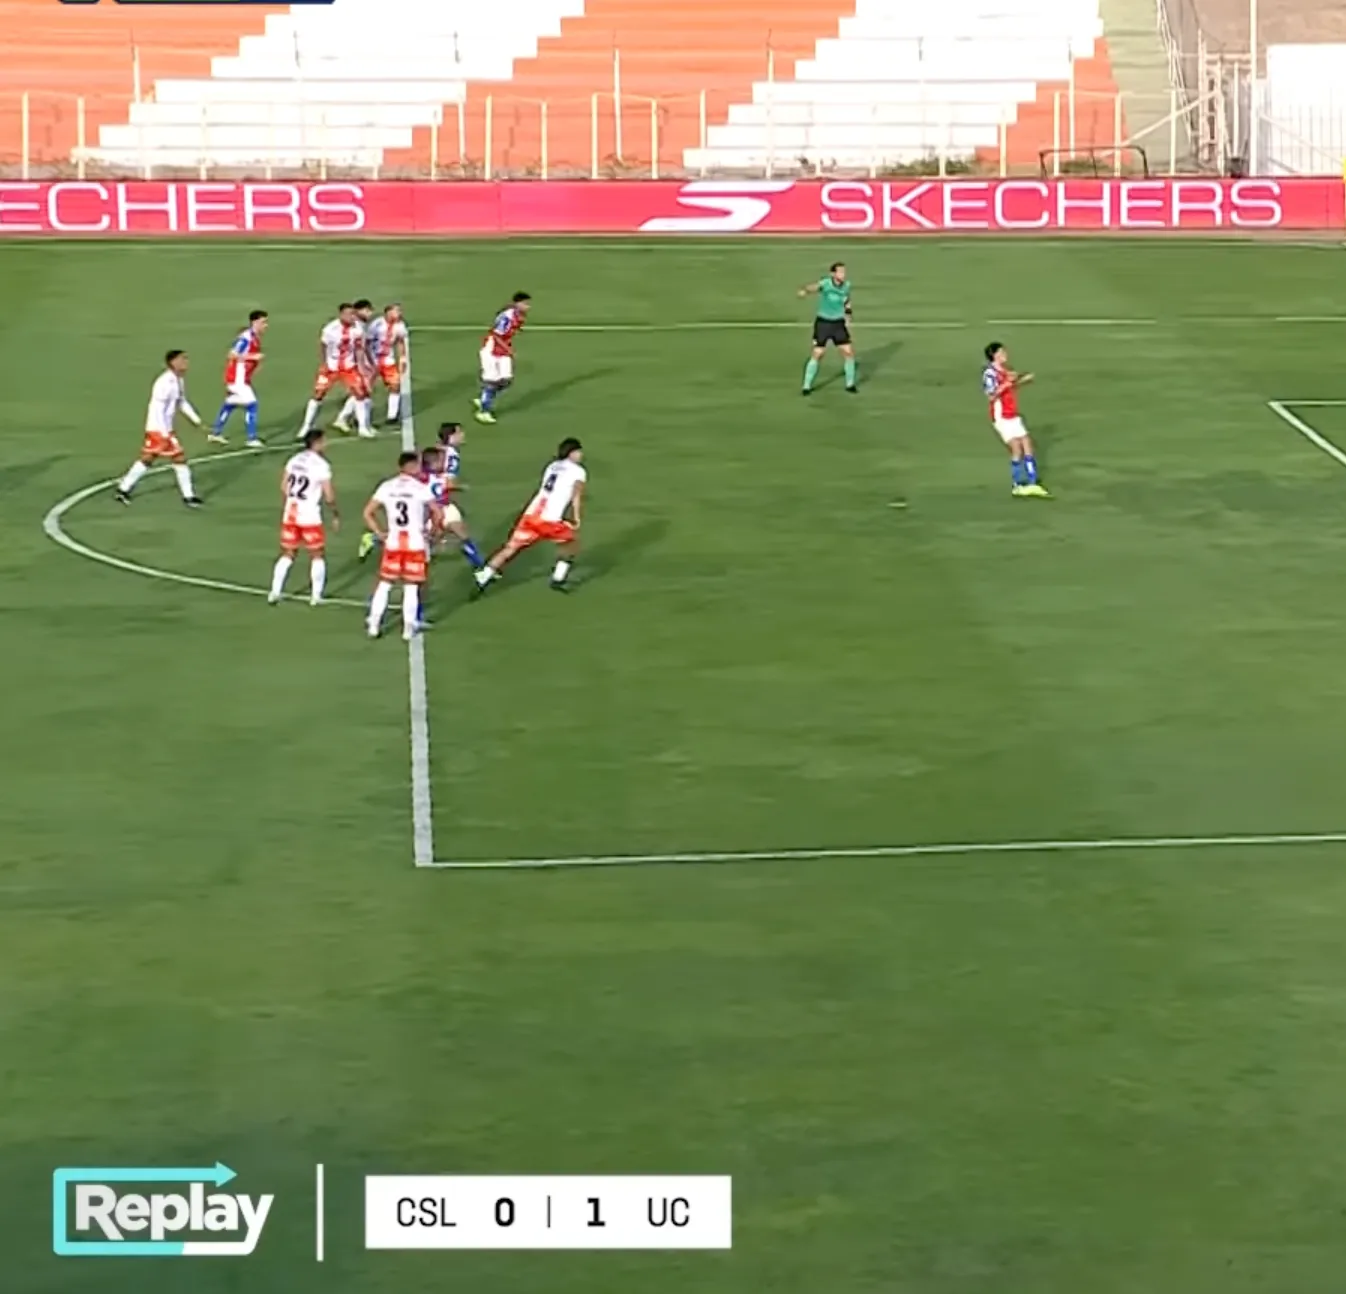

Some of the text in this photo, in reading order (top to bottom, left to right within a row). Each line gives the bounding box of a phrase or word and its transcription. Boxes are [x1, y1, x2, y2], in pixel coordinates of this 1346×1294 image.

[0, 183, 365, 231] ECHERS
[820, 180, 1282, 229] SKECHERS
[287, 473, 310, 500] 22
[395, 501, 409, 526] 3
